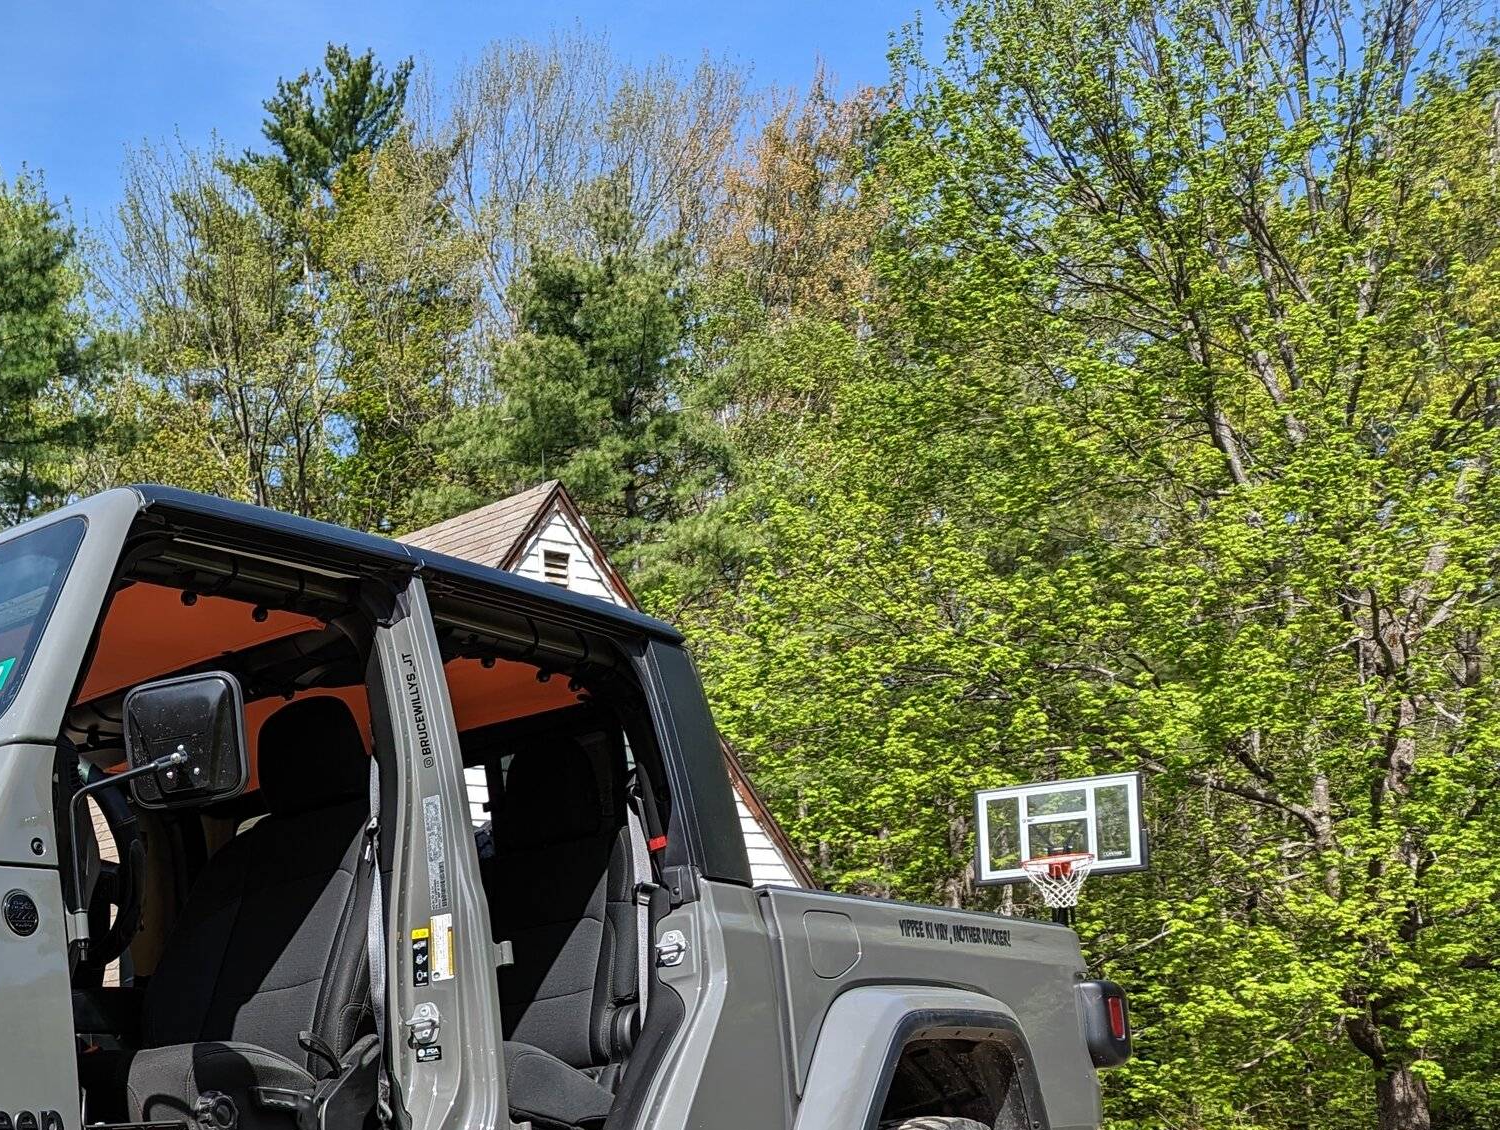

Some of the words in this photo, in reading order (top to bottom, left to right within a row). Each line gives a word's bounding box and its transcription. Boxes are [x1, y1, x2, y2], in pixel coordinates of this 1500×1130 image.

[401, 653, 432, 756] BRUCEWILLYS_JT
[898, 919, 925, 938] YIPPEE
[925, 921, 934, 939] KI
[953, 924, 982, 943] MOTHER
